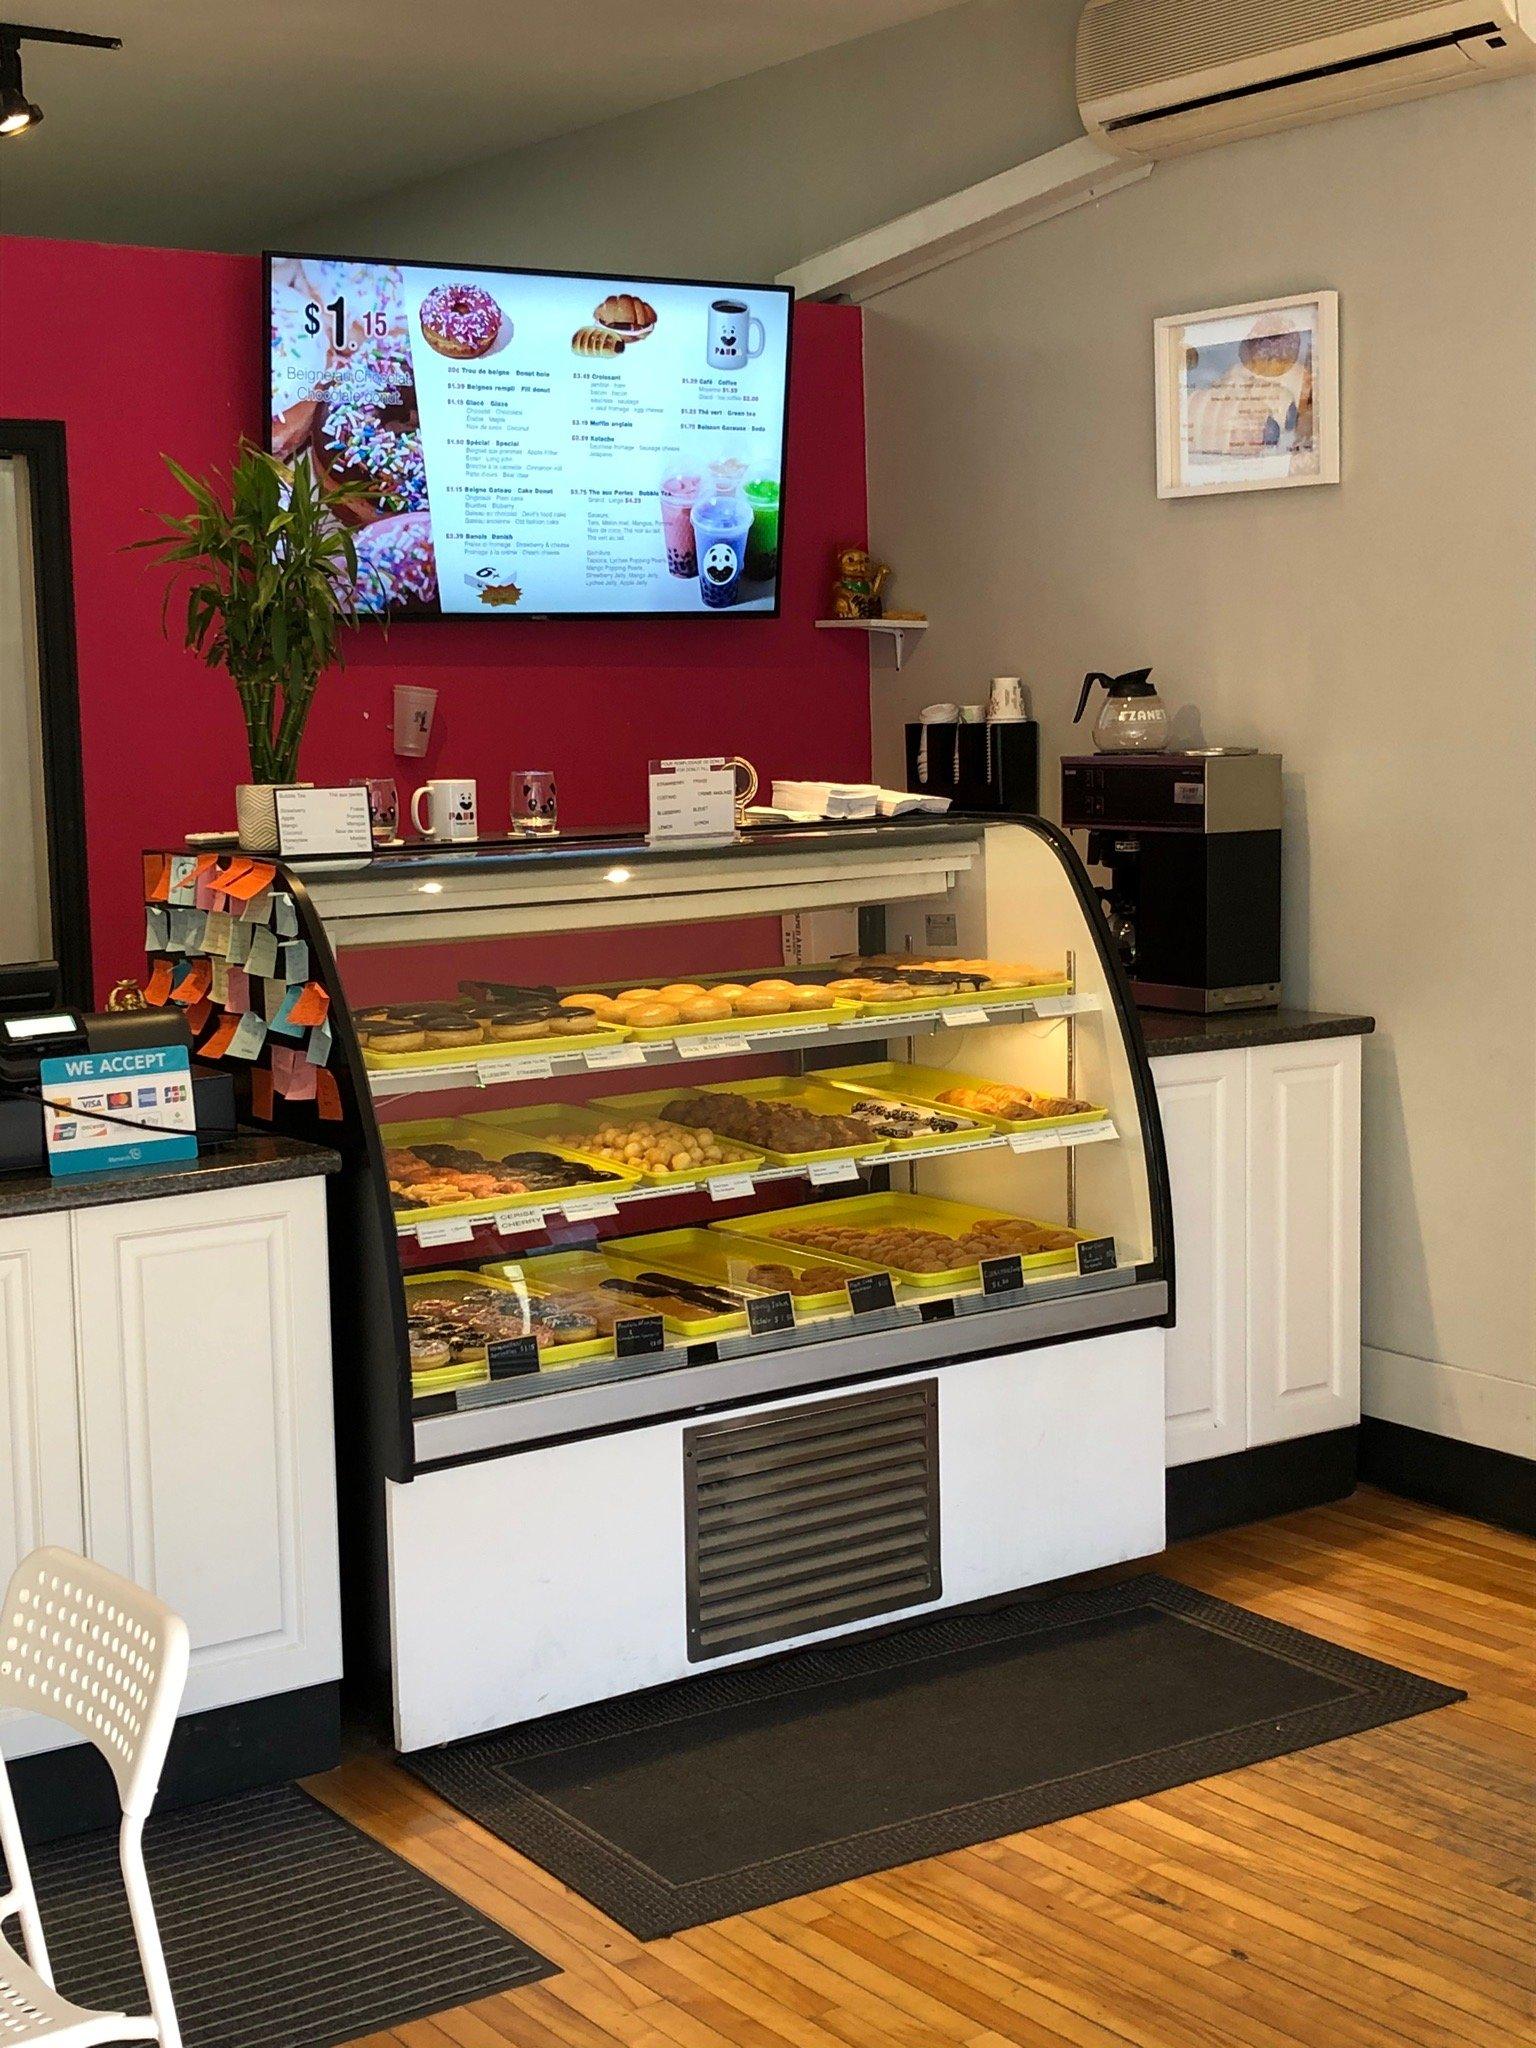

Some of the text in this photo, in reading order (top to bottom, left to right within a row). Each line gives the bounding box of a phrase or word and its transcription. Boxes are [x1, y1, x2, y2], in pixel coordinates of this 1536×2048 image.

[65, 1052, 167, 1077] WE ACCEPT
[81, 1100, 103, 1109] VISA
[499, 1210, 536, 1221] CERISE
[501, 1216, 543, 1230] CHERRY
